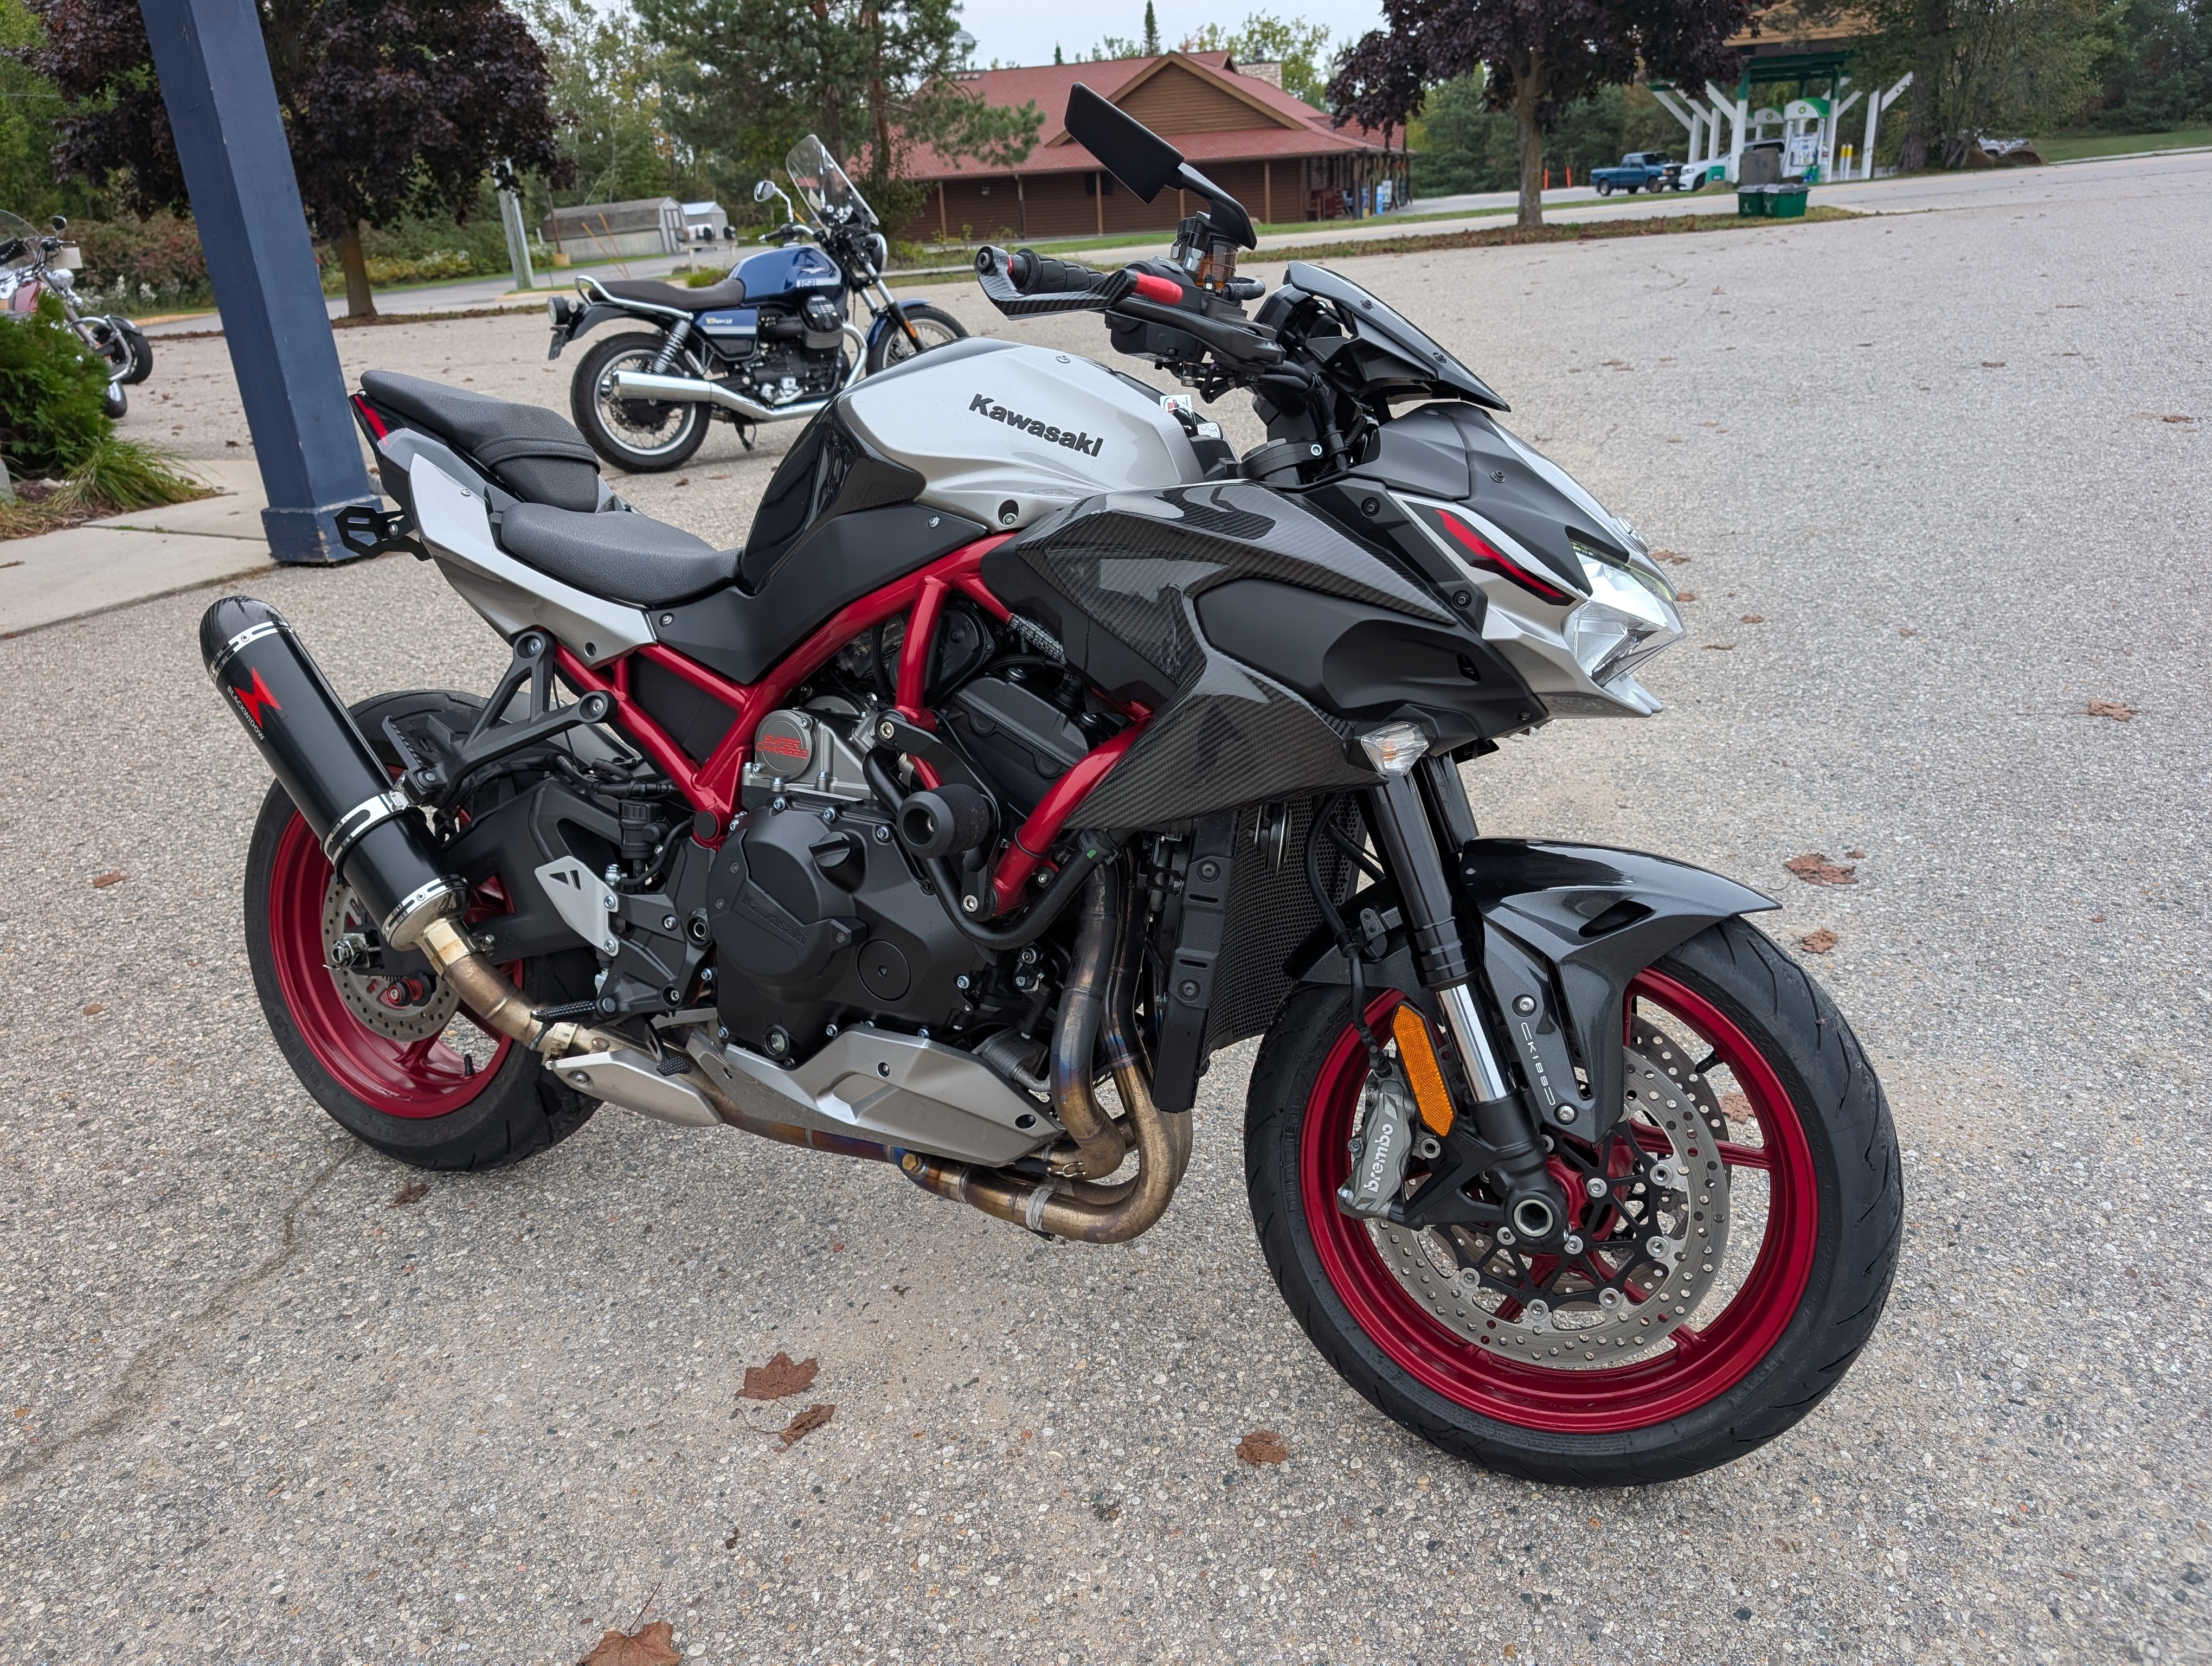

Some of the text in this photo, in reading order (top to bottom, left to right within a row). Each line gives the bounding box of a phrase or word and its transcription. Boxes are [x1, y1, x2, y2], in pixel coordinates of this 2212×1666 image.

[969, 393, 1104, 457] Kawasaki
[227, 685, 265, 741] BLACKWIDOW
[756, 741, 809, 759] CHARGED
[763, 734, 801, 749] SUPER
[742, 892, 808, 946] Kawasaki
[1363, 1124, 1394, 1193] brembo
